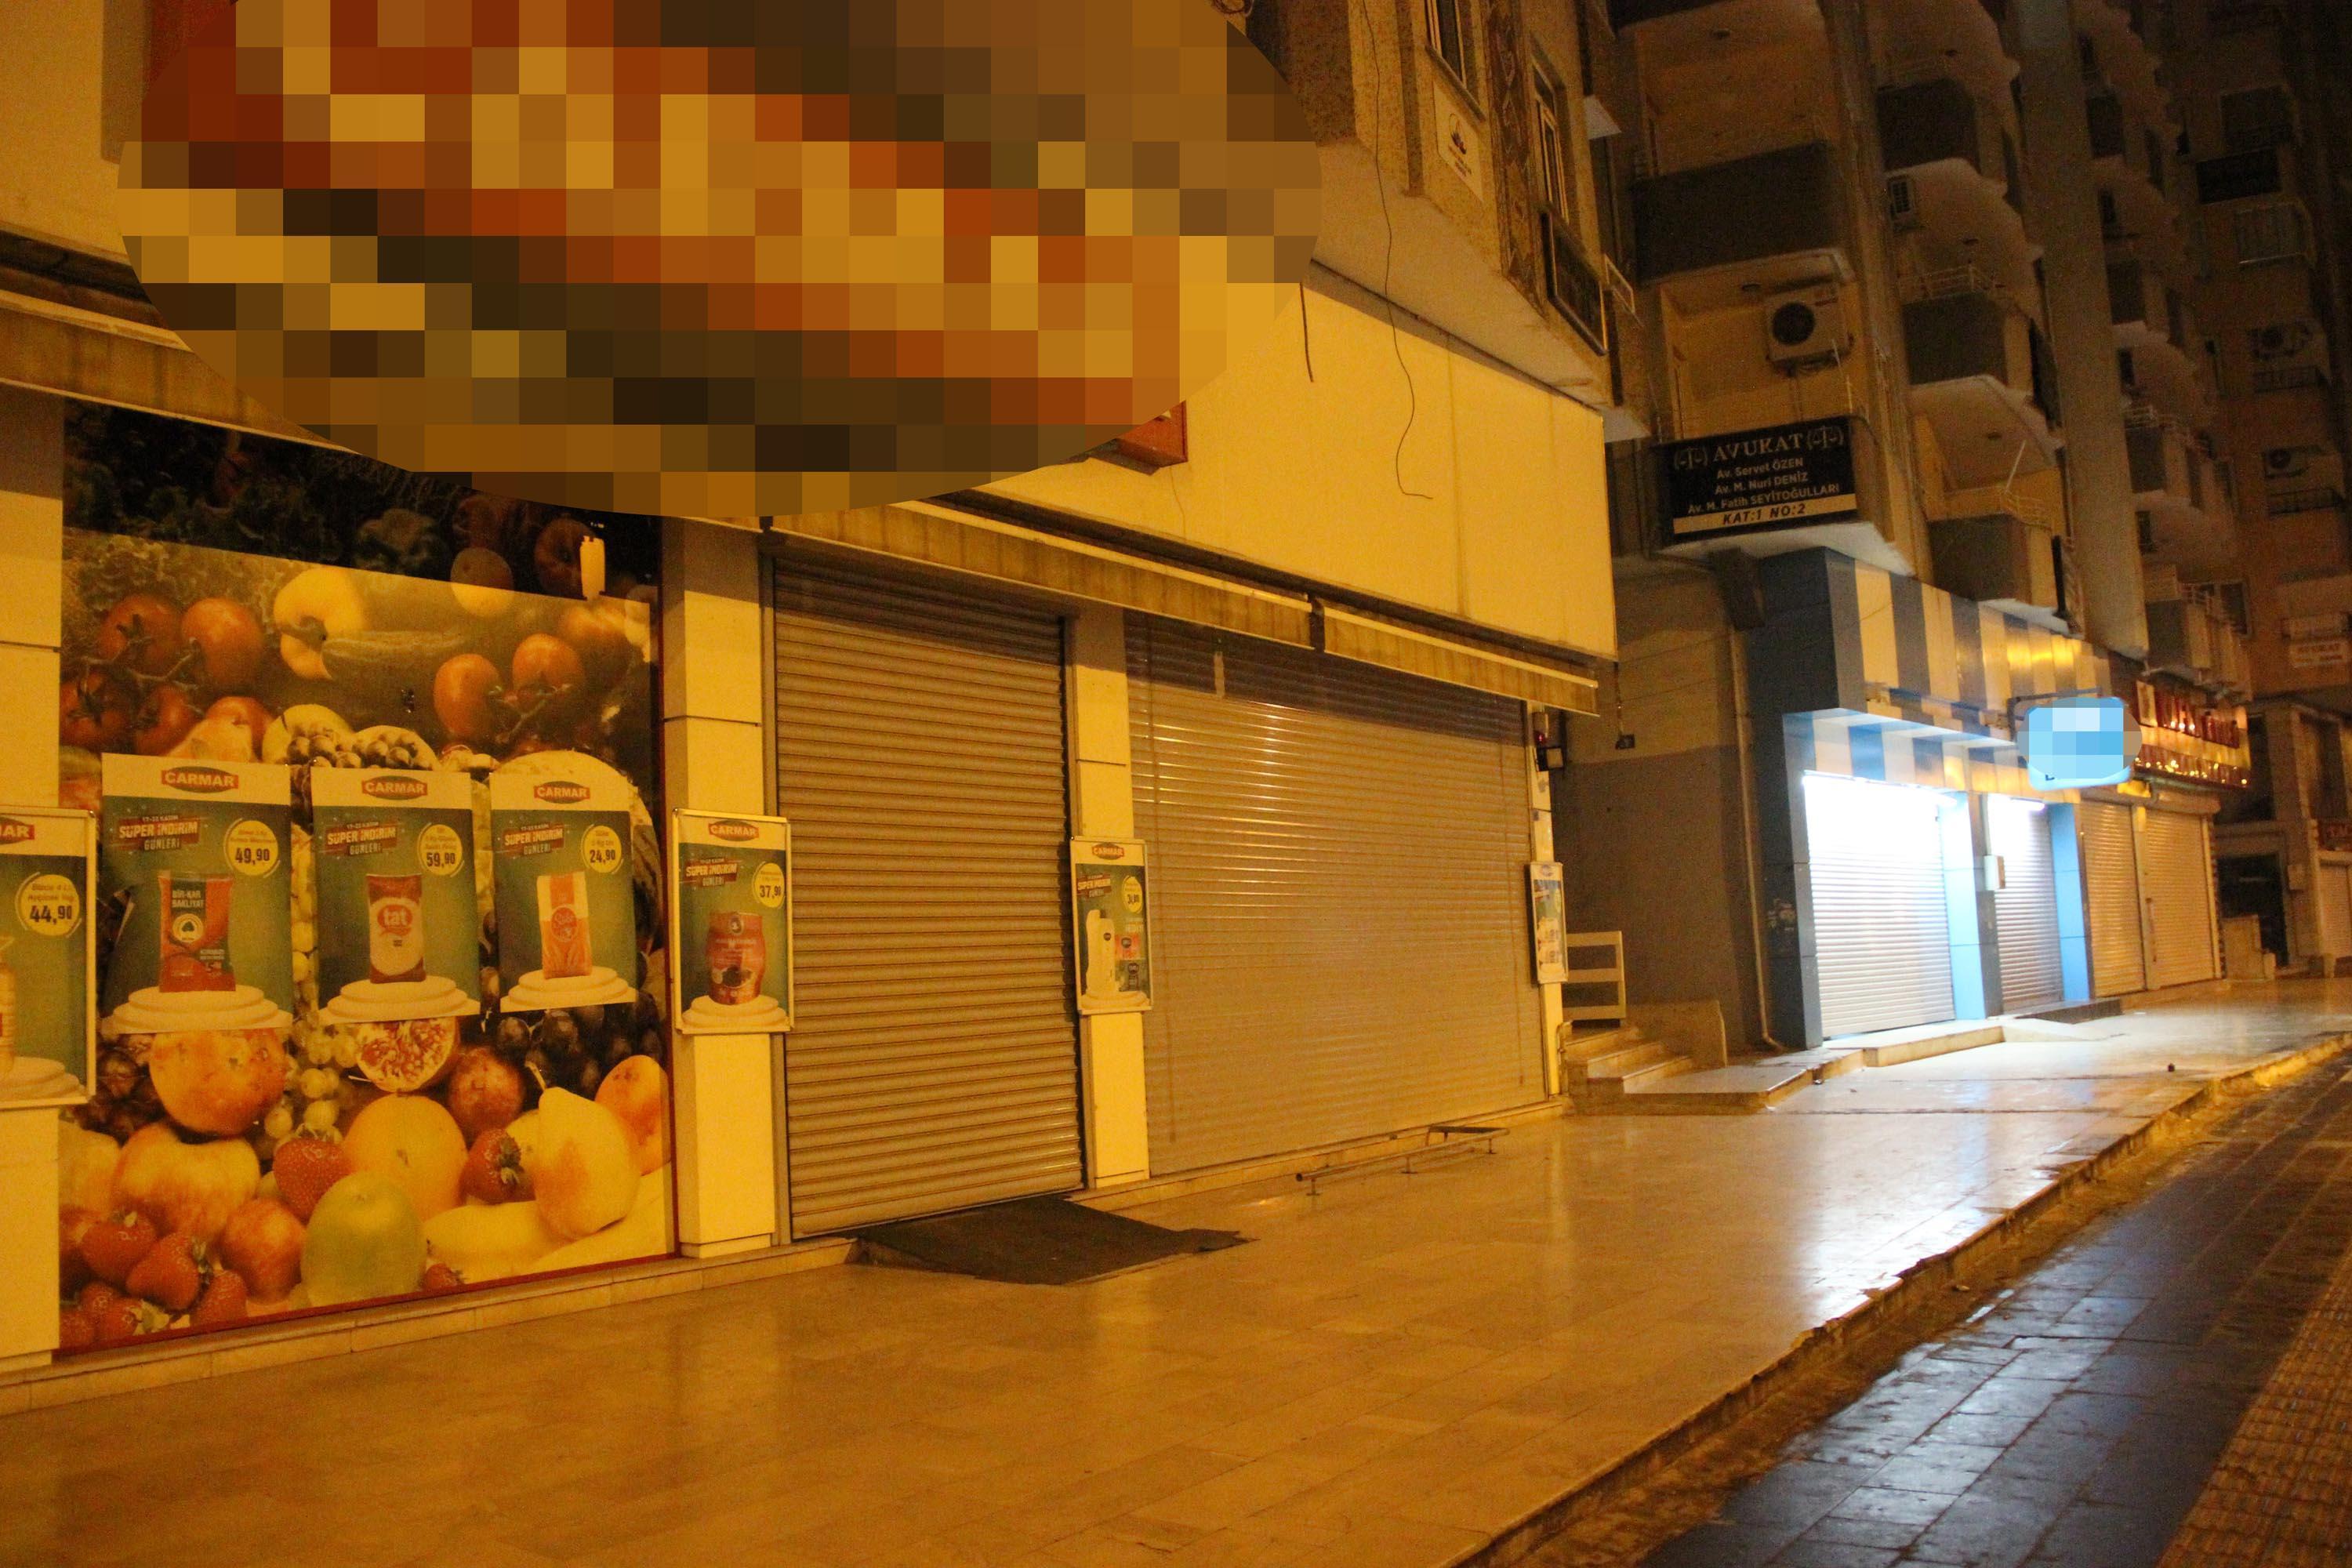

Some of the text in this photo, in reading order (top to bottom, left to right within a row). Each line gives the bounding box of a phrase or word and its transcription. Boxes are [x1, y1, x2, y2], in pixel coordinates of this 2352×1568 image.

[1713, 434, 1803, 462] AVUKAT
[1735, 463, 1769, 477] Servet
[1773, 458, 1803, 470] ÖZEN
[1749, 477, 1771, 490] Nuri
[1774, 471, 1808, 486] DENİZ
[1722, 503, 1806, 524] KAT:1 NO:2
[165, 772, 234, 787] CARMAR
[365, 782, 424, 794] CARMAR
[537, 786, 587, 797] CARMAR
[119, 824, 154, 839] SÜPER
[710, 825, 756, 837] CARMAR
[235, 848, 270, 866] 49,90
[426, 852, 456, 868] 59,90
[590, 849, 615, 865] 24,90
[30, 905, 73, 925] 44,90
